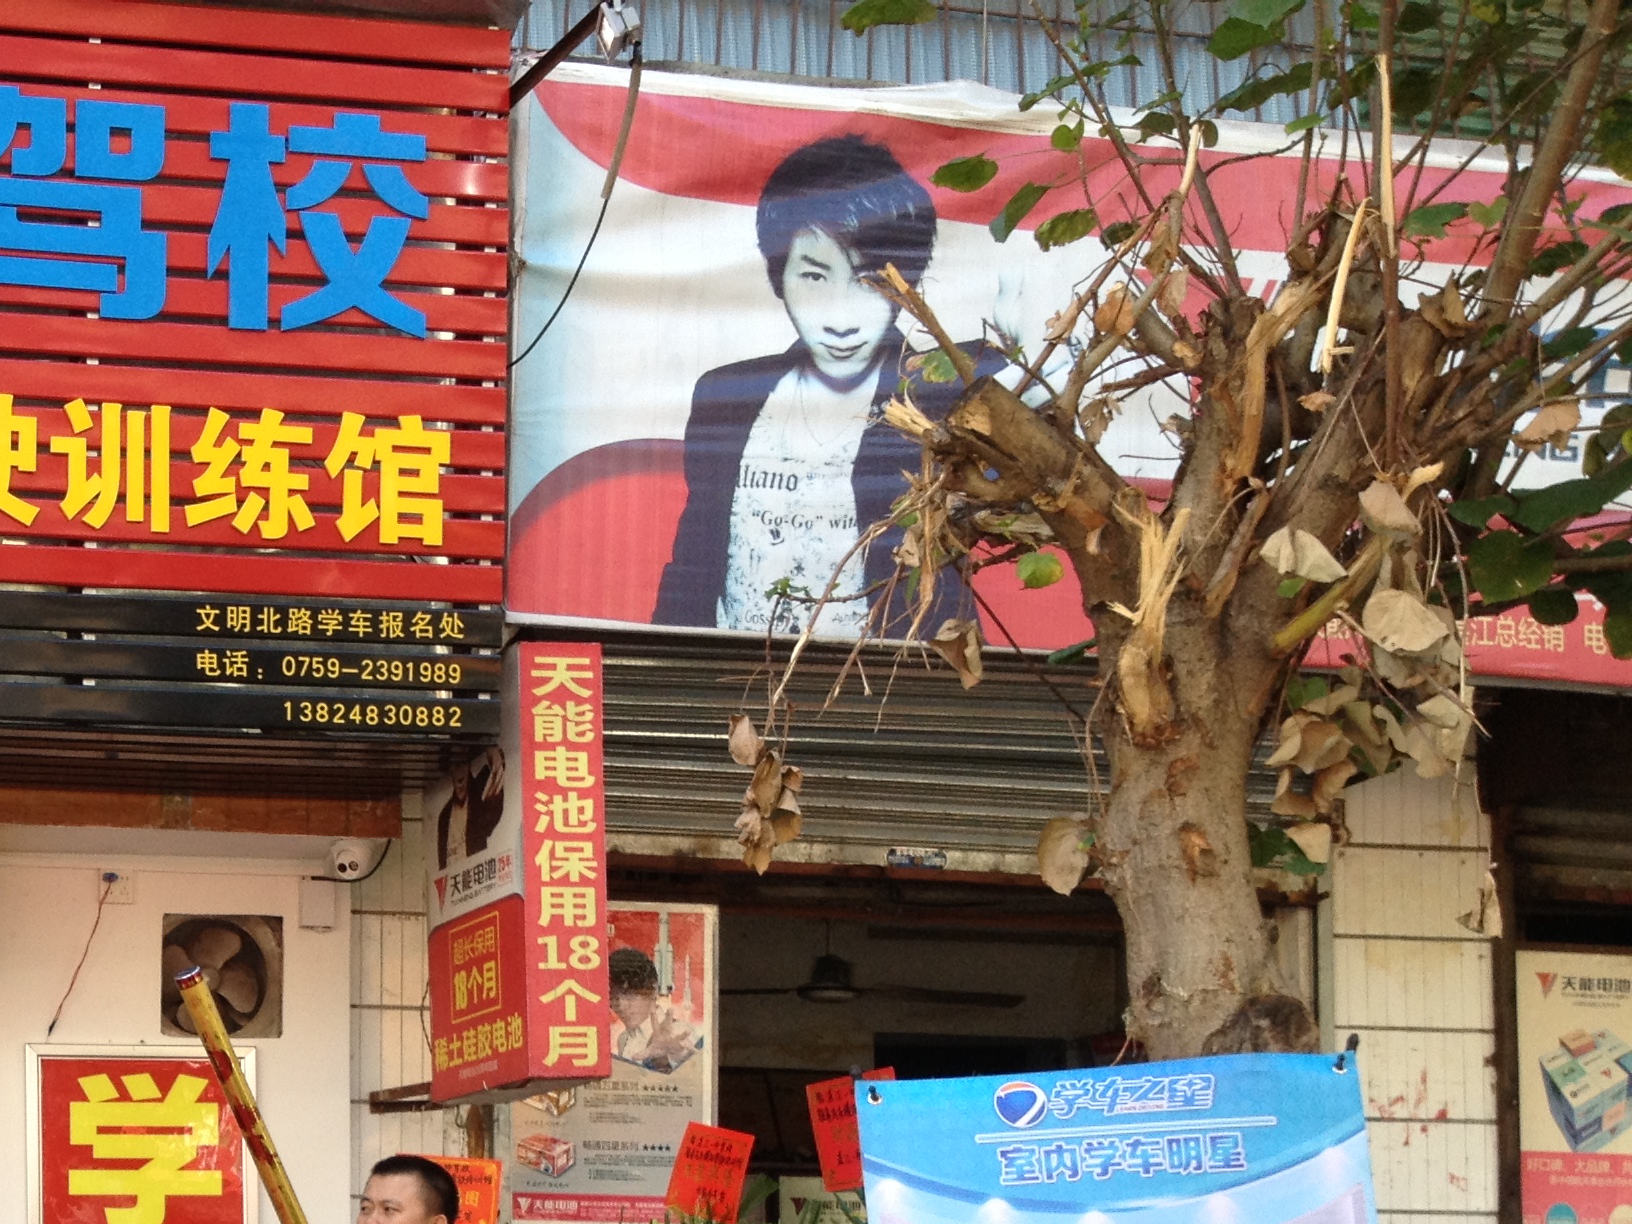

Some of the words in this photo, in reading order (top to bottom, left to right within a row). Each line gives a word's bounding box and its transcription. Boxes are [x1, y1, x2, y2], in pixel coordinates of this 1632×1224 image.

[194, 603, 466, 642] 文明北路学车报名处
[282, 699, 463, 729] 13824830882
[530, 655, 602, 1069] 天能电池保用18个月
[454, 959, 497, 1011] 18个月
[1049, 1073, 1215, 1119] 学车之星
[997, 1131, 1247, 1186] 室内学车明星
